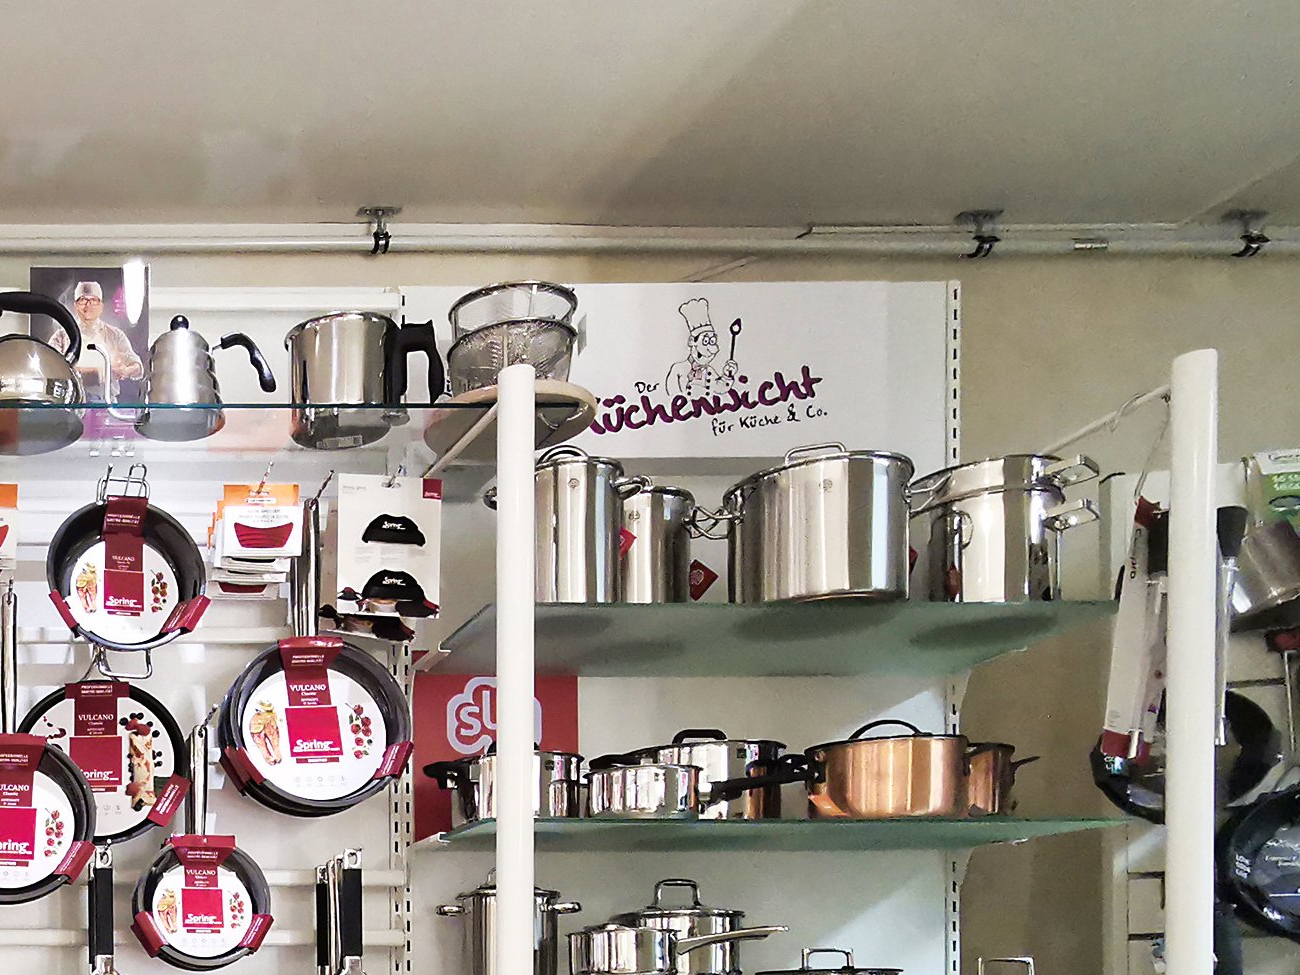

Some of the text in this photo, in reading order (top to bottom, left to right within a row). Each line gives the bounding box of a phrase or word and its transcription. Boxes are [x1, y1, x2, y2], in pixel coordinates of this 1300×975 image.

[635, 381, 660, 394] Der
[711, 402, 828, 437] für Küche & Co.
[108, 595, 138, 607] Spring
[290, 684, 327, 692] VULCANO
[78, 714, 114, 722] VULCANO
[295, 739, 334, 753] Spring
[80, 769, 115, 782] pring
[187, 913, 218, 925] Spring
